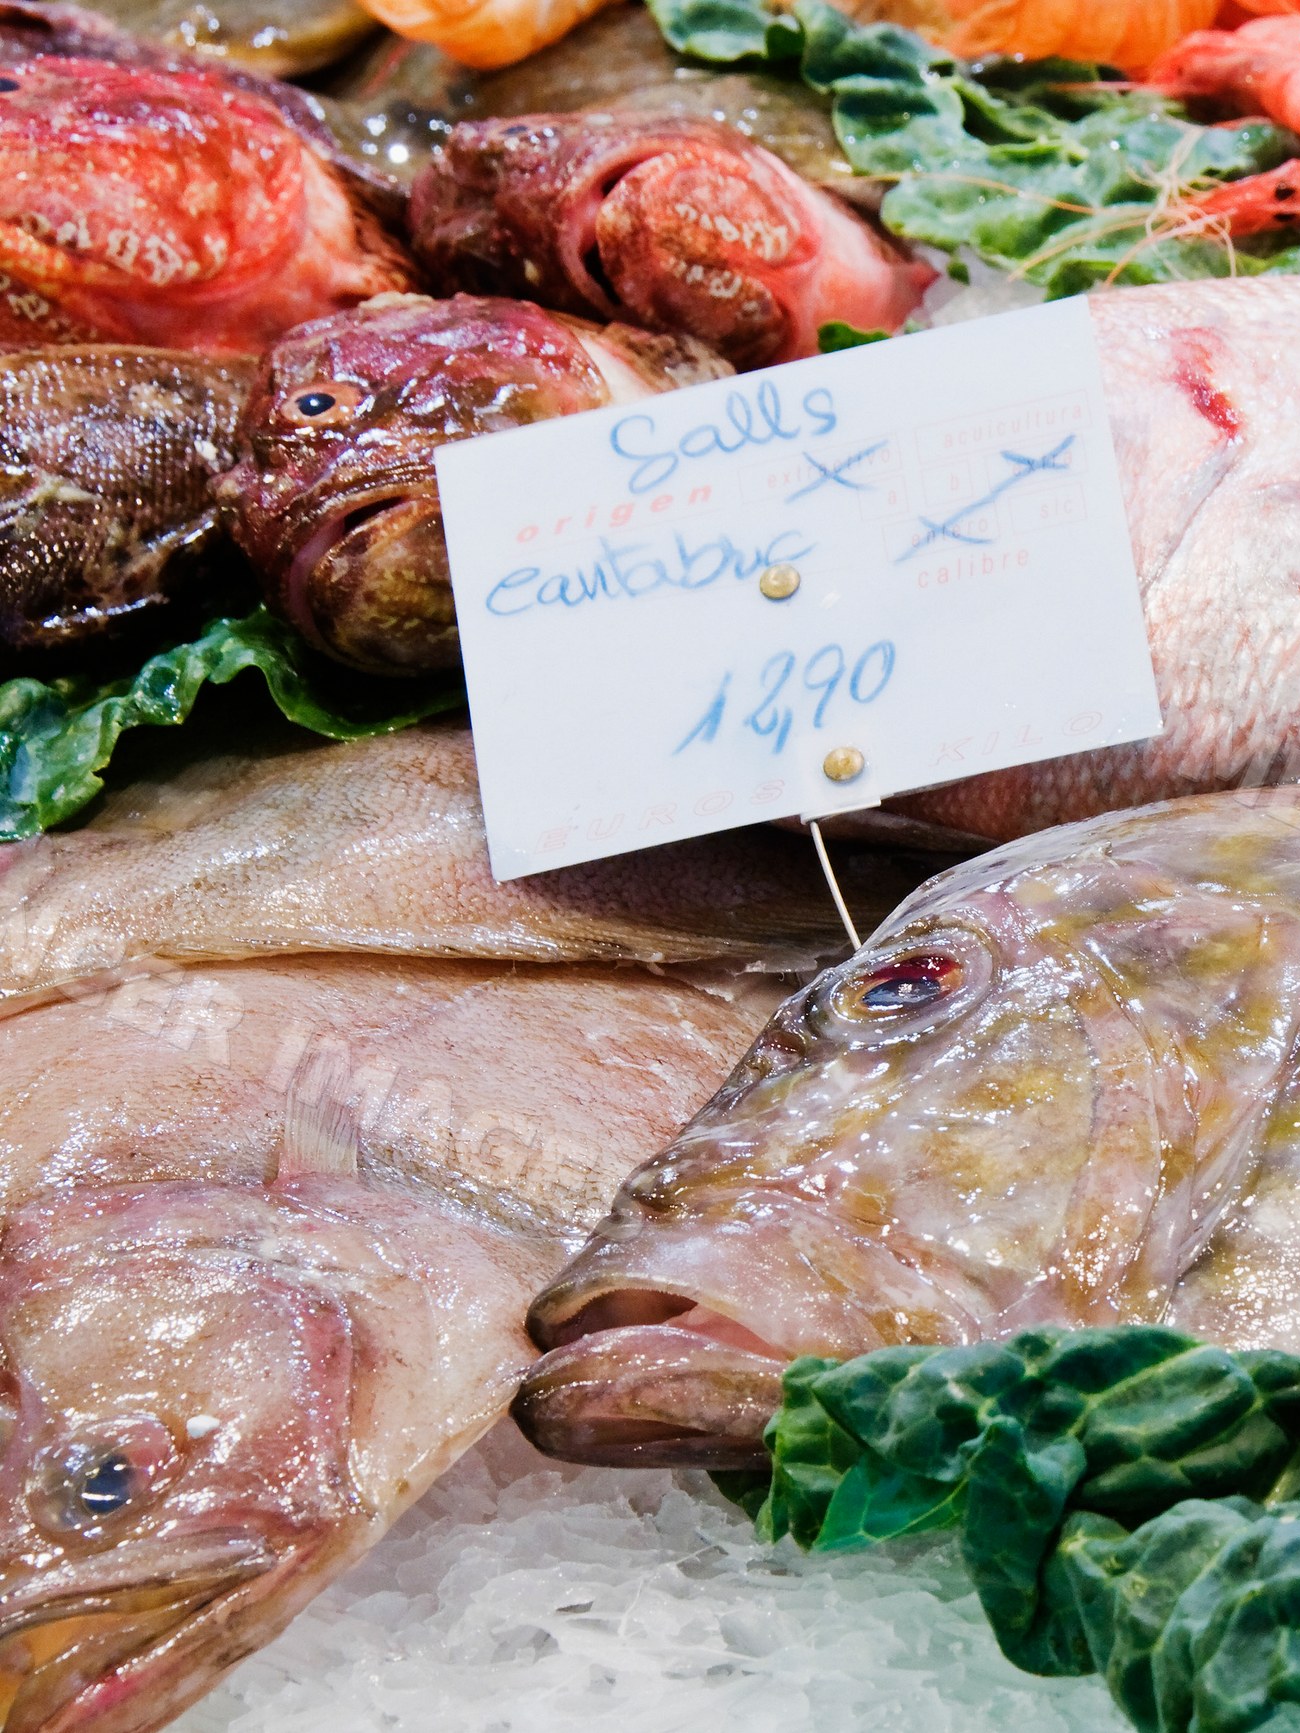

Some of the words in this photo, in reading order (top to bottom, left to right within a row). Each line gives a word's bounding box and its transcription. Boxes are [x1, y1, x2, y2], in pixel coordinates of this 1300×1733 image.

[515, 484, 713, 543] origen
[917, 548, 1030, 589] calibre
[672, 639, 895, 757] 12,90
[931, 711, 1104, 768] KILO
[532, 777, 788, 855] EUROS
